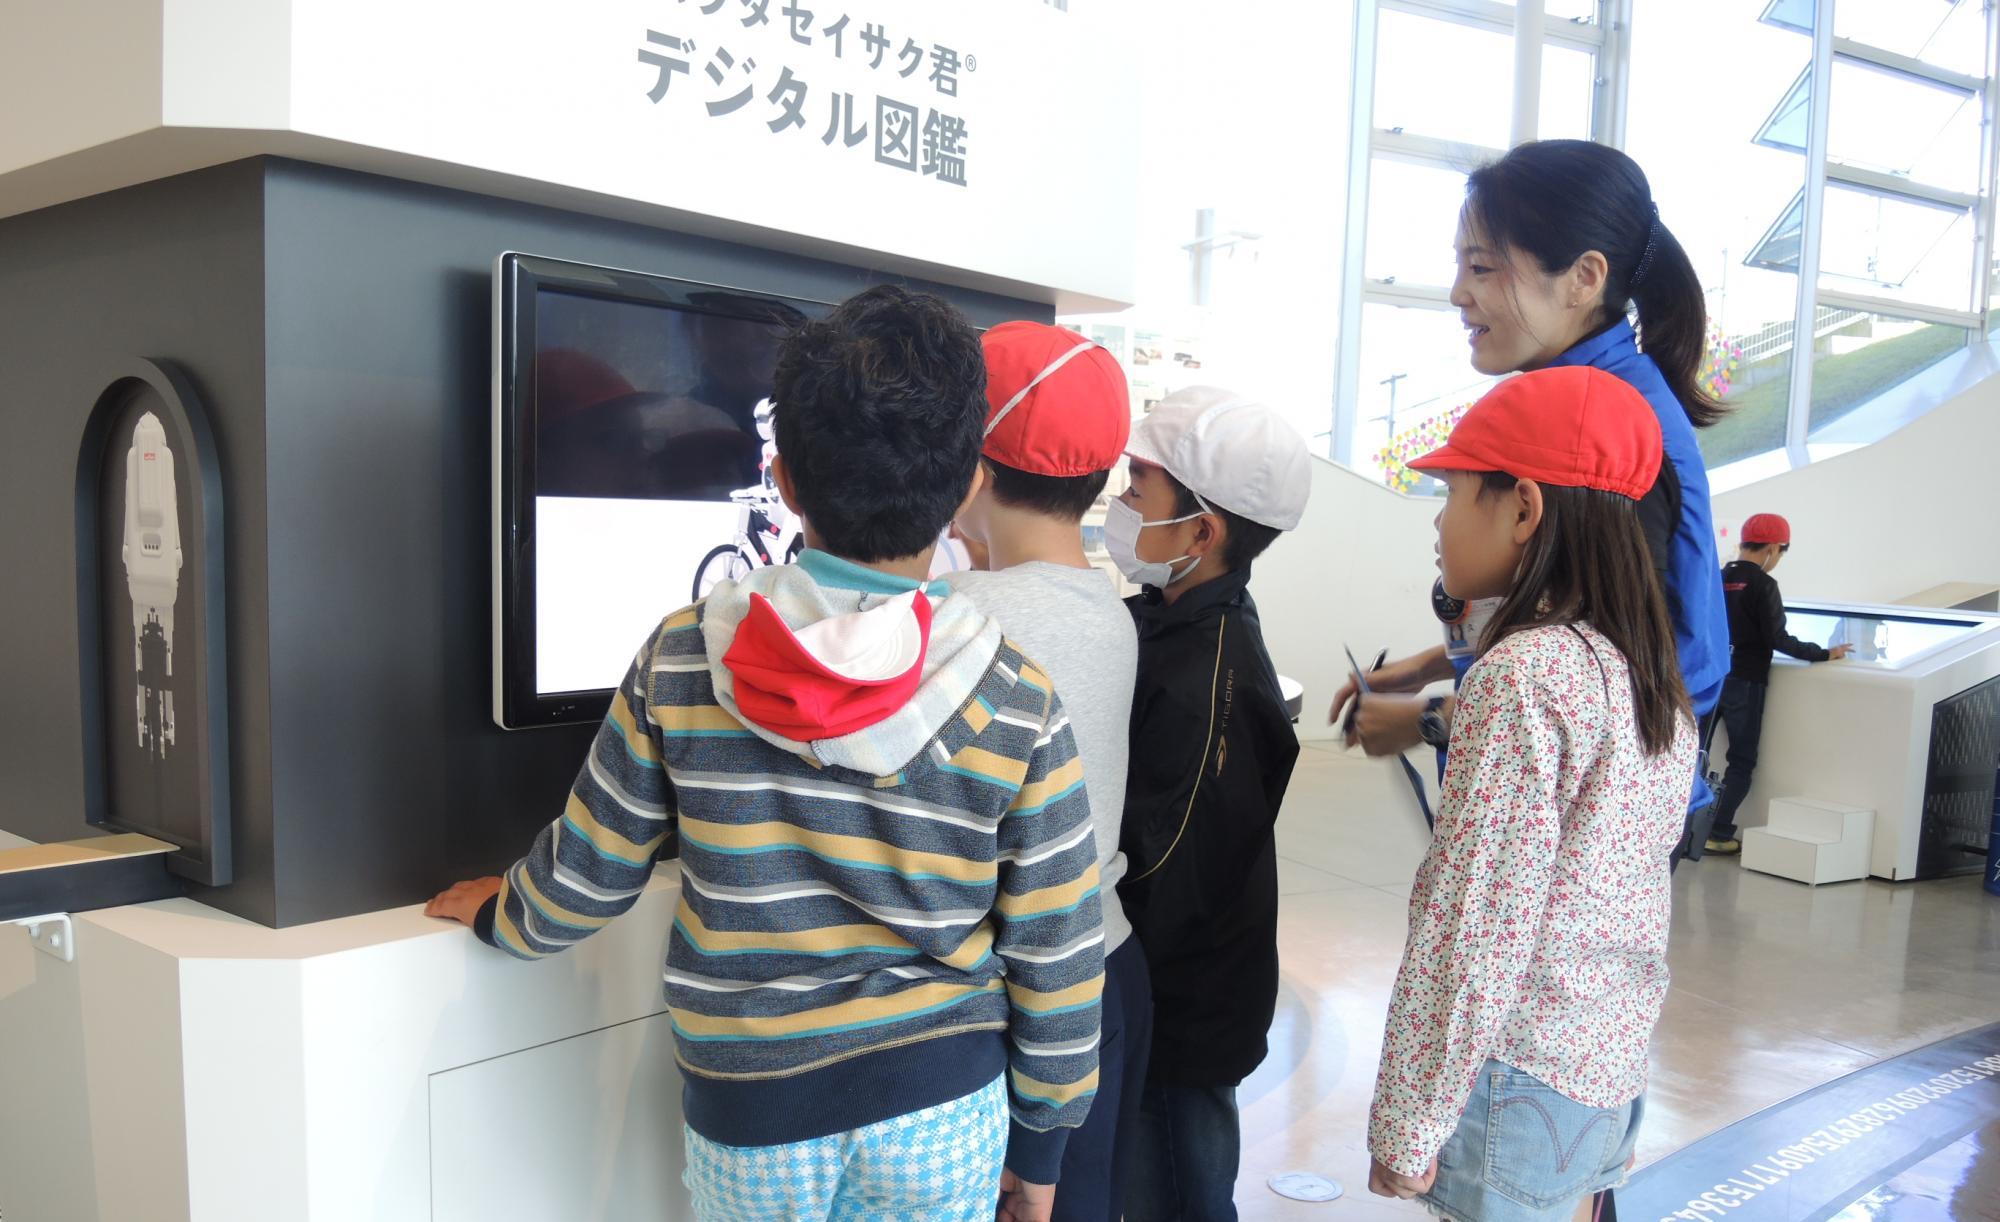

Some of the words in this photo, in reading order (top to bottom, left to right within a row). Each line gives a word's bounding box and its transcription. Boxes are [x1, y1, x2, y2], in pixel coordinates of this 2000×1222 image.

[638, 28, 968, 188] デジタル図鑑
